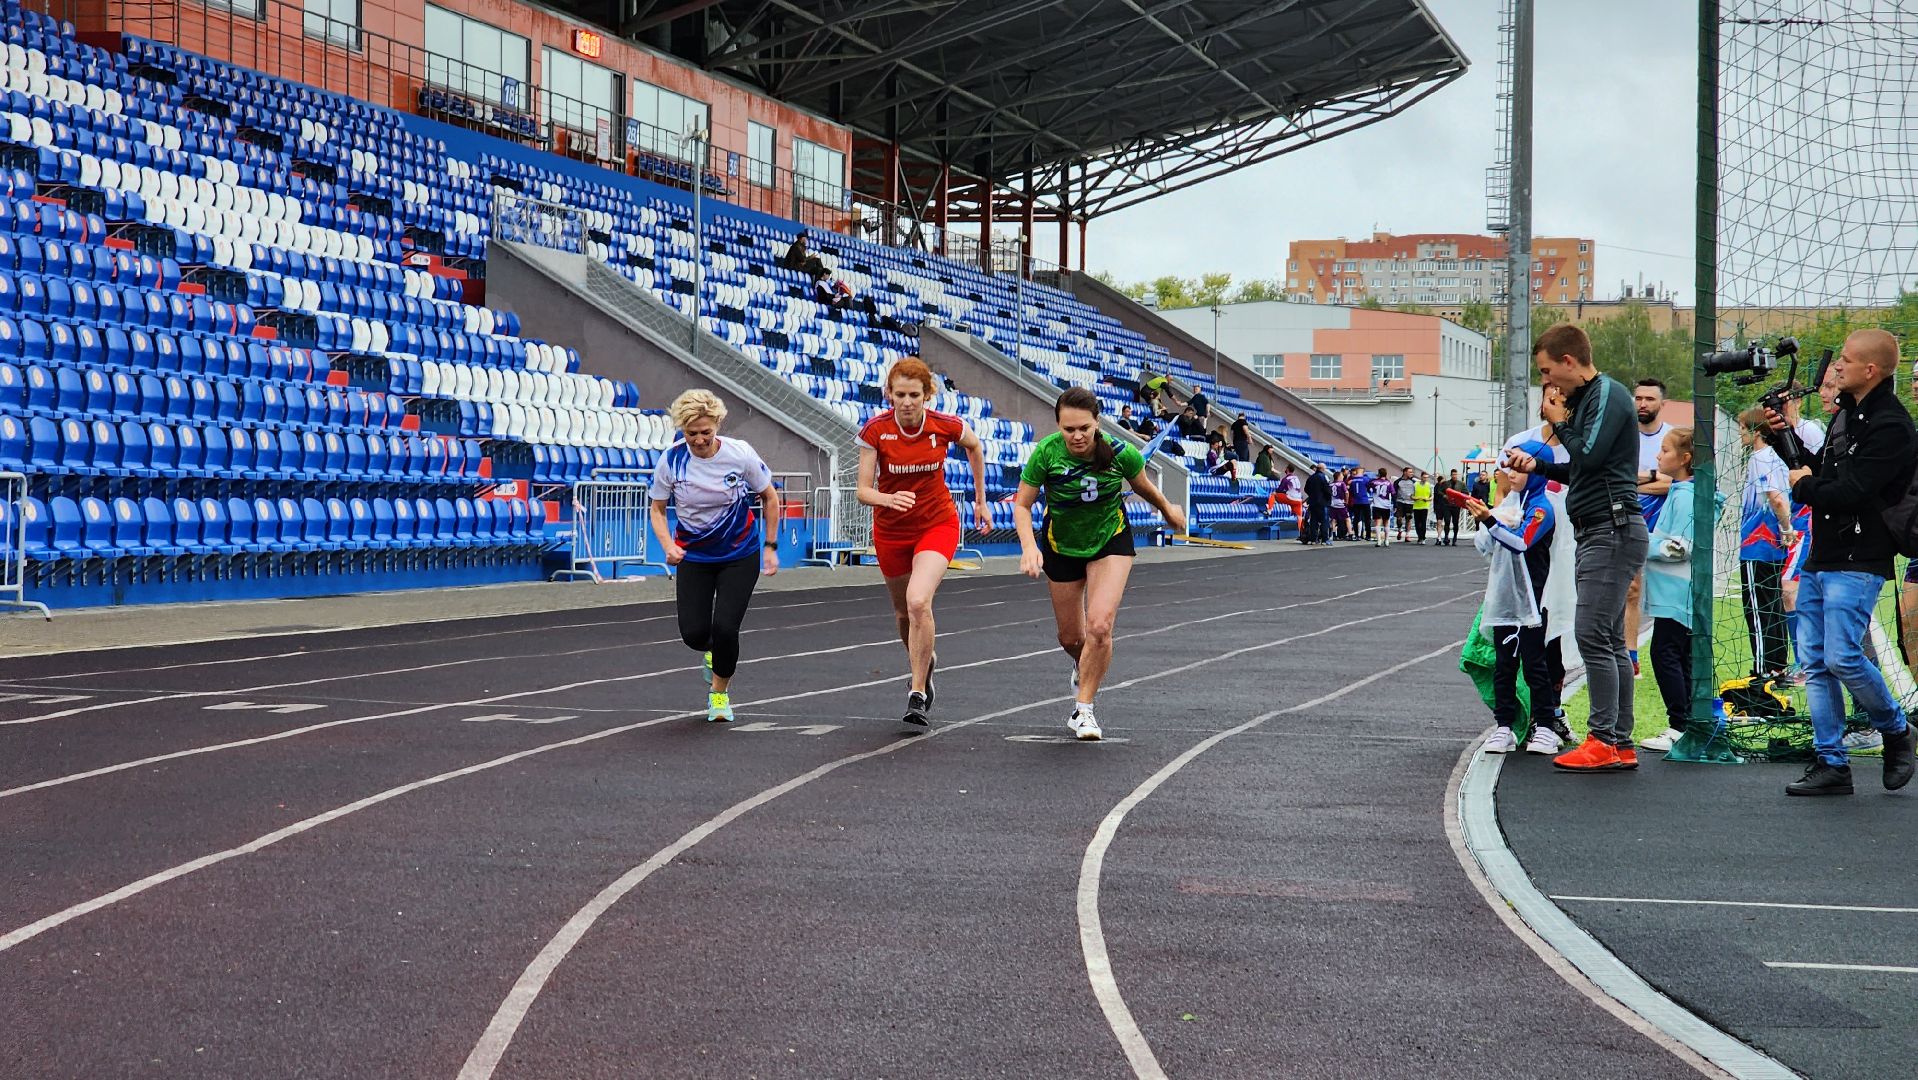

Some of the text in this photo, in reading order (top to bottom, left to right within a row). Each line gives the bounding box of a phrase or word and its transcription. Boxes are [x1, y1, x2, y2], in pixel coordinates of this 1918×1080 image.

[928, 433, 937, 449] 1
[1080, 476, 1099, 502] 3
[1332, 484, 1338, 497] 8
